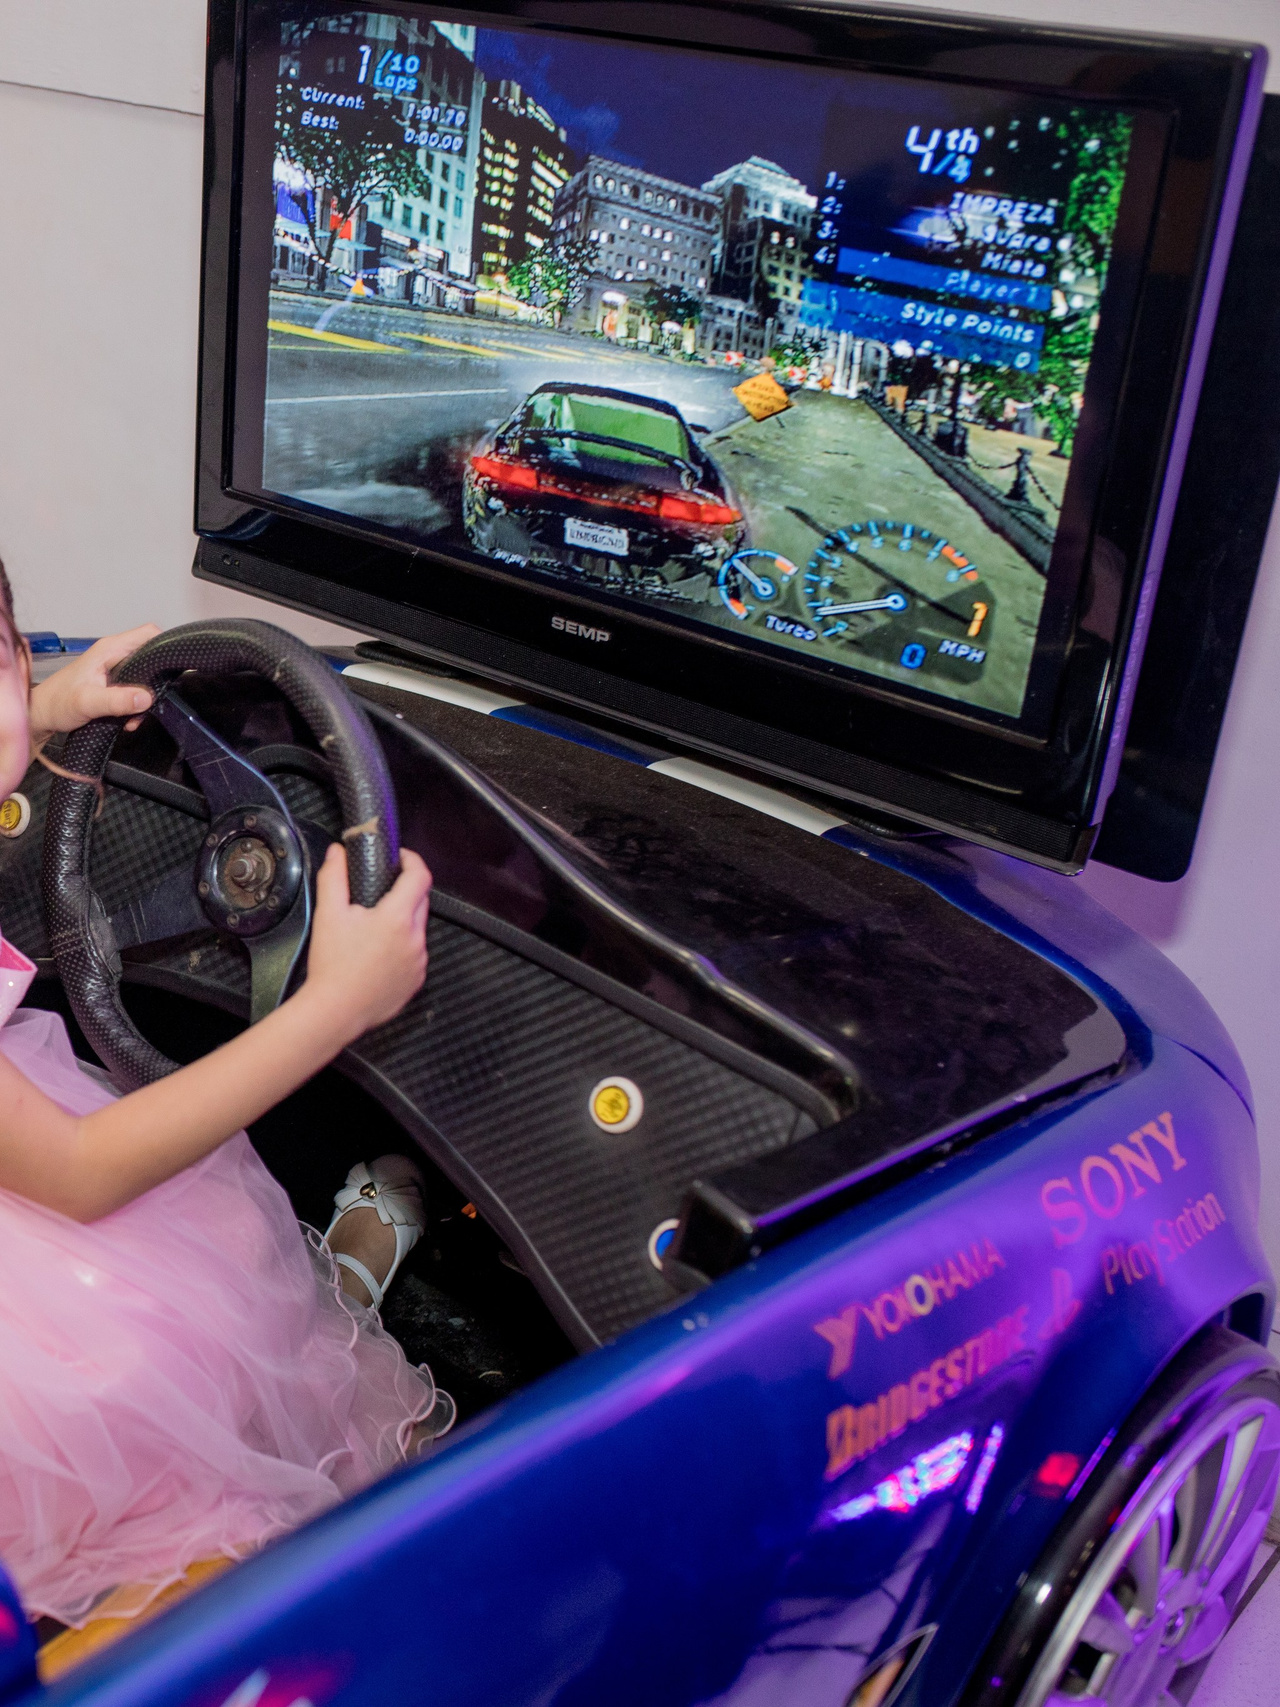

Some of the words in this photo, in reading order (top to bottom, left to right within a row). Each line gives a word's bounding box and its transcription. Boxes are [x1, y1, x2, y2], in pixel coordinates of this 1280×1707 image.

[373, 68, 418, 95] Laps
[300, 87, 366, 110] Current:
[300, 111, 339, 131] Best:
[403, 127, 465, 152] 0:00.00
[949, 191, 1056, 226] IMPREZA
[900, 302, 958, 329] Style
[960, 313, 1036, 345] Points
[1013, 351, 1032, 370] 0
[551, 615, 611, 643] SEMP
[763, 614, 818, 642] Turbo
[967, 601, 988, 637] 1
[900, 642, 927, 670] 0
[938, 639, 986, 664] MPH
[1040, 1110, 1187, 1248] SONY
[1101, 1192, 1226, 1295] PlayStation
